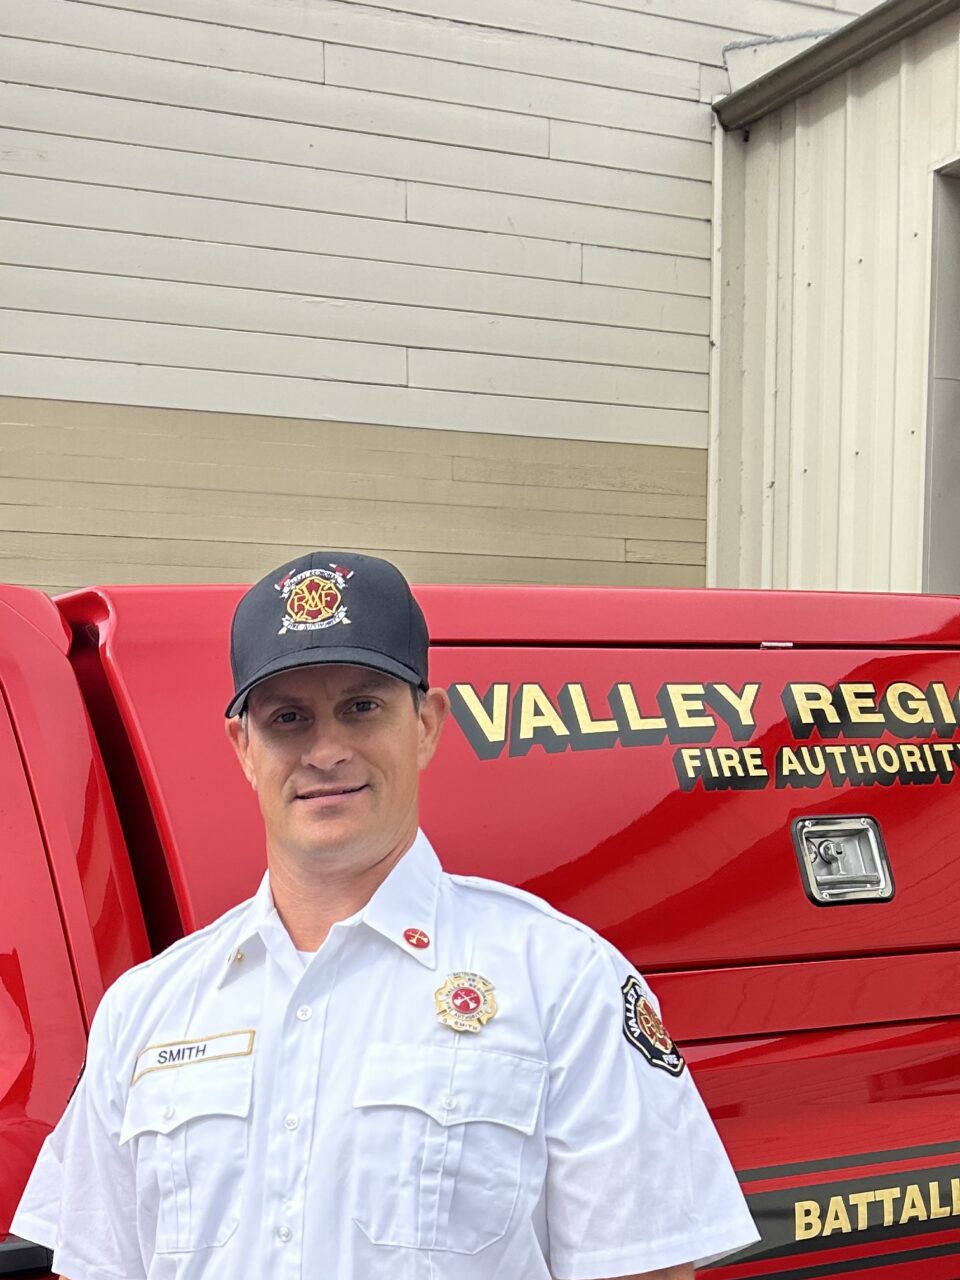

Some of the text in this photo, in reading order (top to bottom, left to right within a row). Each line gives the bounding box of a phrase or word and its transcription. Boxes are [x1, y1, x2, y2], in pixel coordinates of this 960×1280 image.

[452, 682, 960, 744] VALLEY REGI
[679, 743, 960, 779] FIRE AUTHORIT
[625, 986, 641, 1038] VALLEY
[157, 1044, 207, 1065] SMITH
